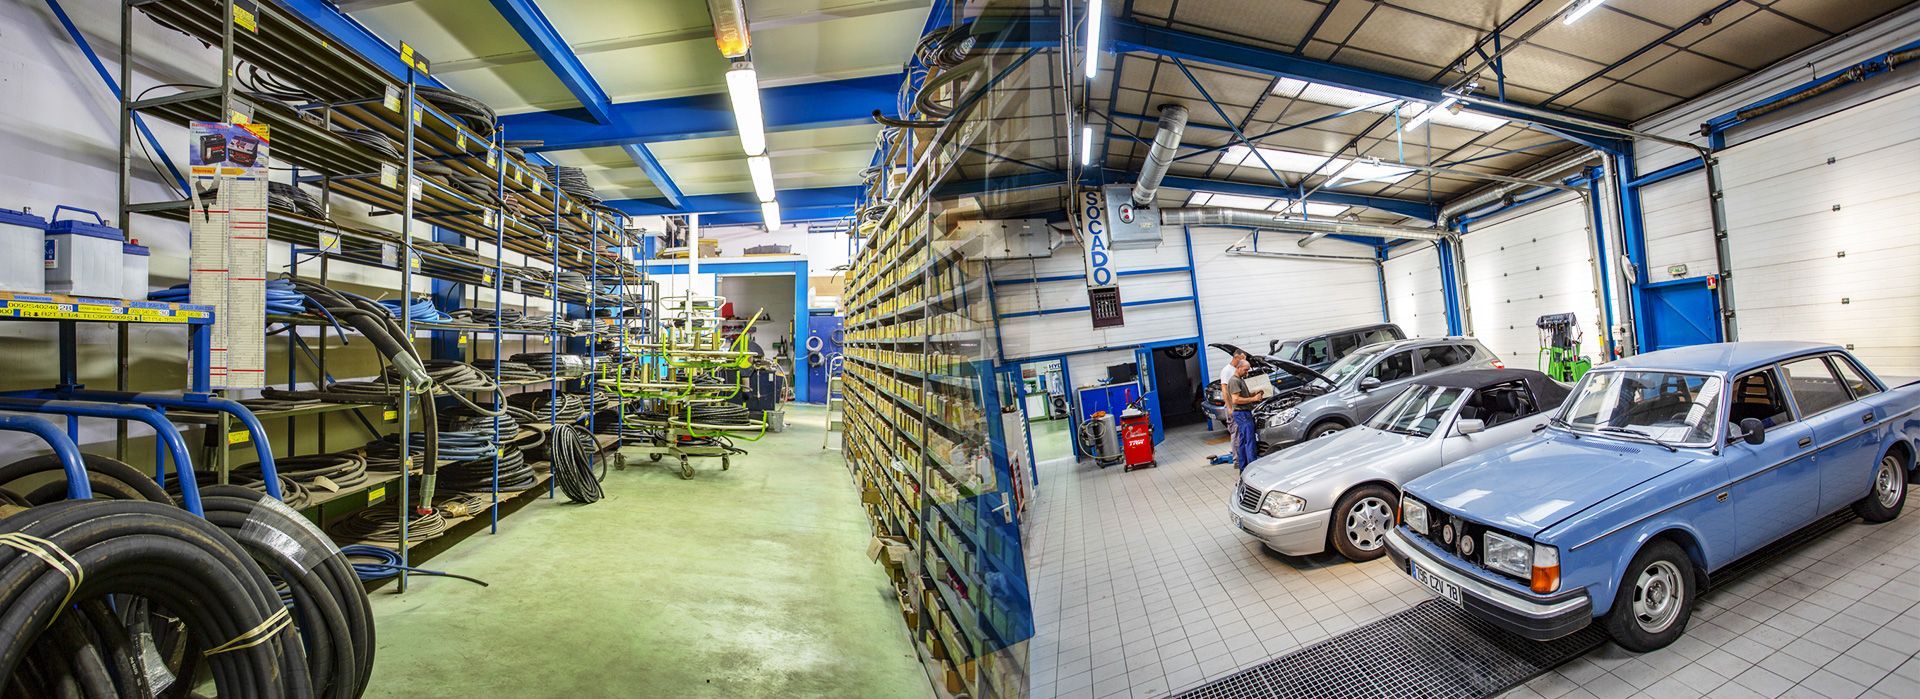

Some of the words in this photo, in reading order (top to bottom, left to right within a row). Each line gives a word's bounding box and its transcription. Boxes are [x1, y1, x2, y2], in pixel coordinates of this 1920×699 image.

[1086, 191, 1111, 286] SOCADO
[1430, 574, 1443, 593] CZV
[1447, 584, 1458, 601] 78
